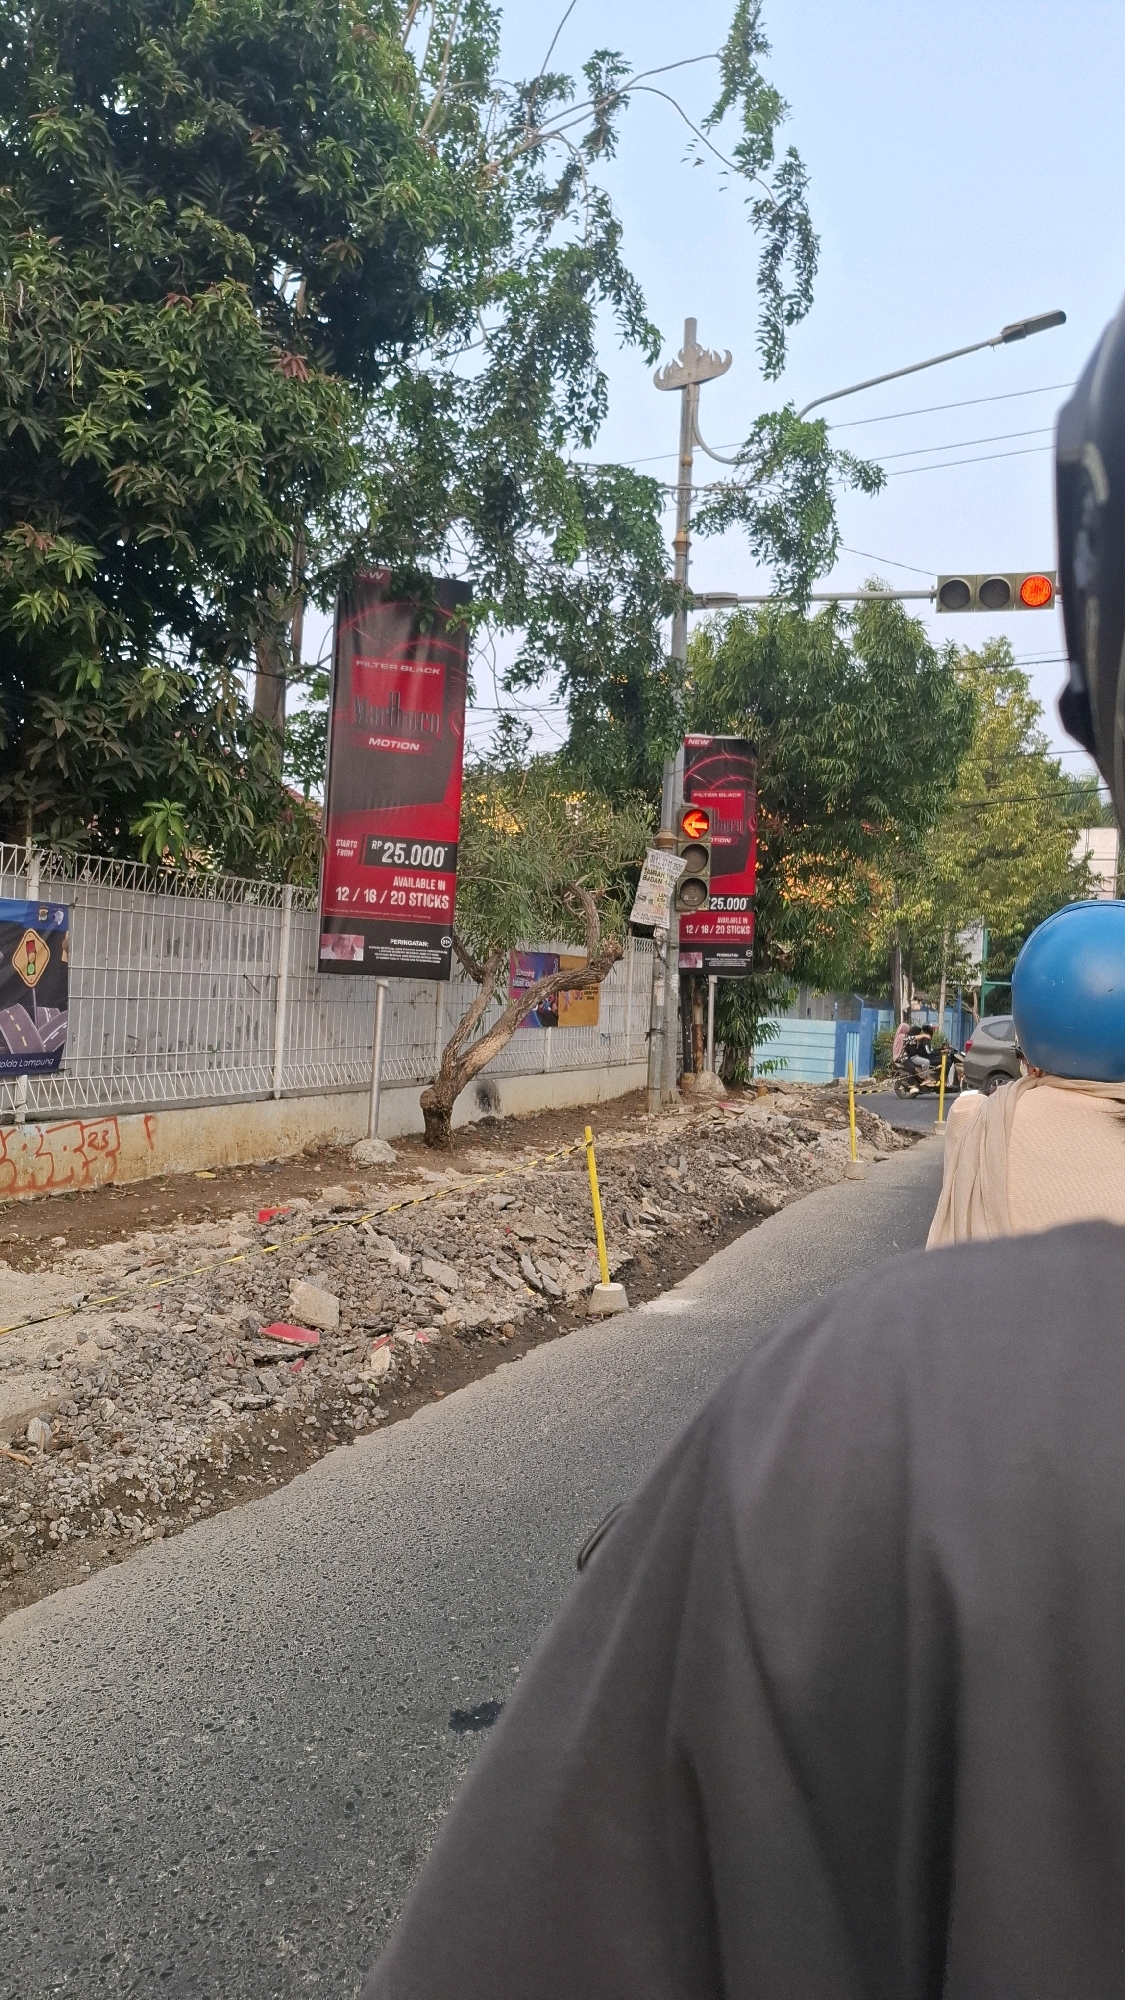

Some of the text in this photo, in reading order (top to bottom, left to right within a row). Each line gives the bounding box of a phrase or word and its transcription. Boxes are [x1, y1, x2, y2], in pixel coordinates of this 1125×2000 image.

[356, 660, 440, 675] FILTER BLACK
[368, 737, 420, 751] MOTION
[335, 839, 358, 848] STARTS
[371, 840, 382, 850] RP
[336, 848, 354, 857] FROM
[393, 876, 446, 891] AVAILABLE IN
[335, 886, 449, 909] 12 / 16 / 20 STICKS
[685, 924, 694, 934] 12
[715, 925, 725, 934] 20
[726, 925, 751, 935] STICKS
[0, 1058, 54, 1068] olda Lampung
